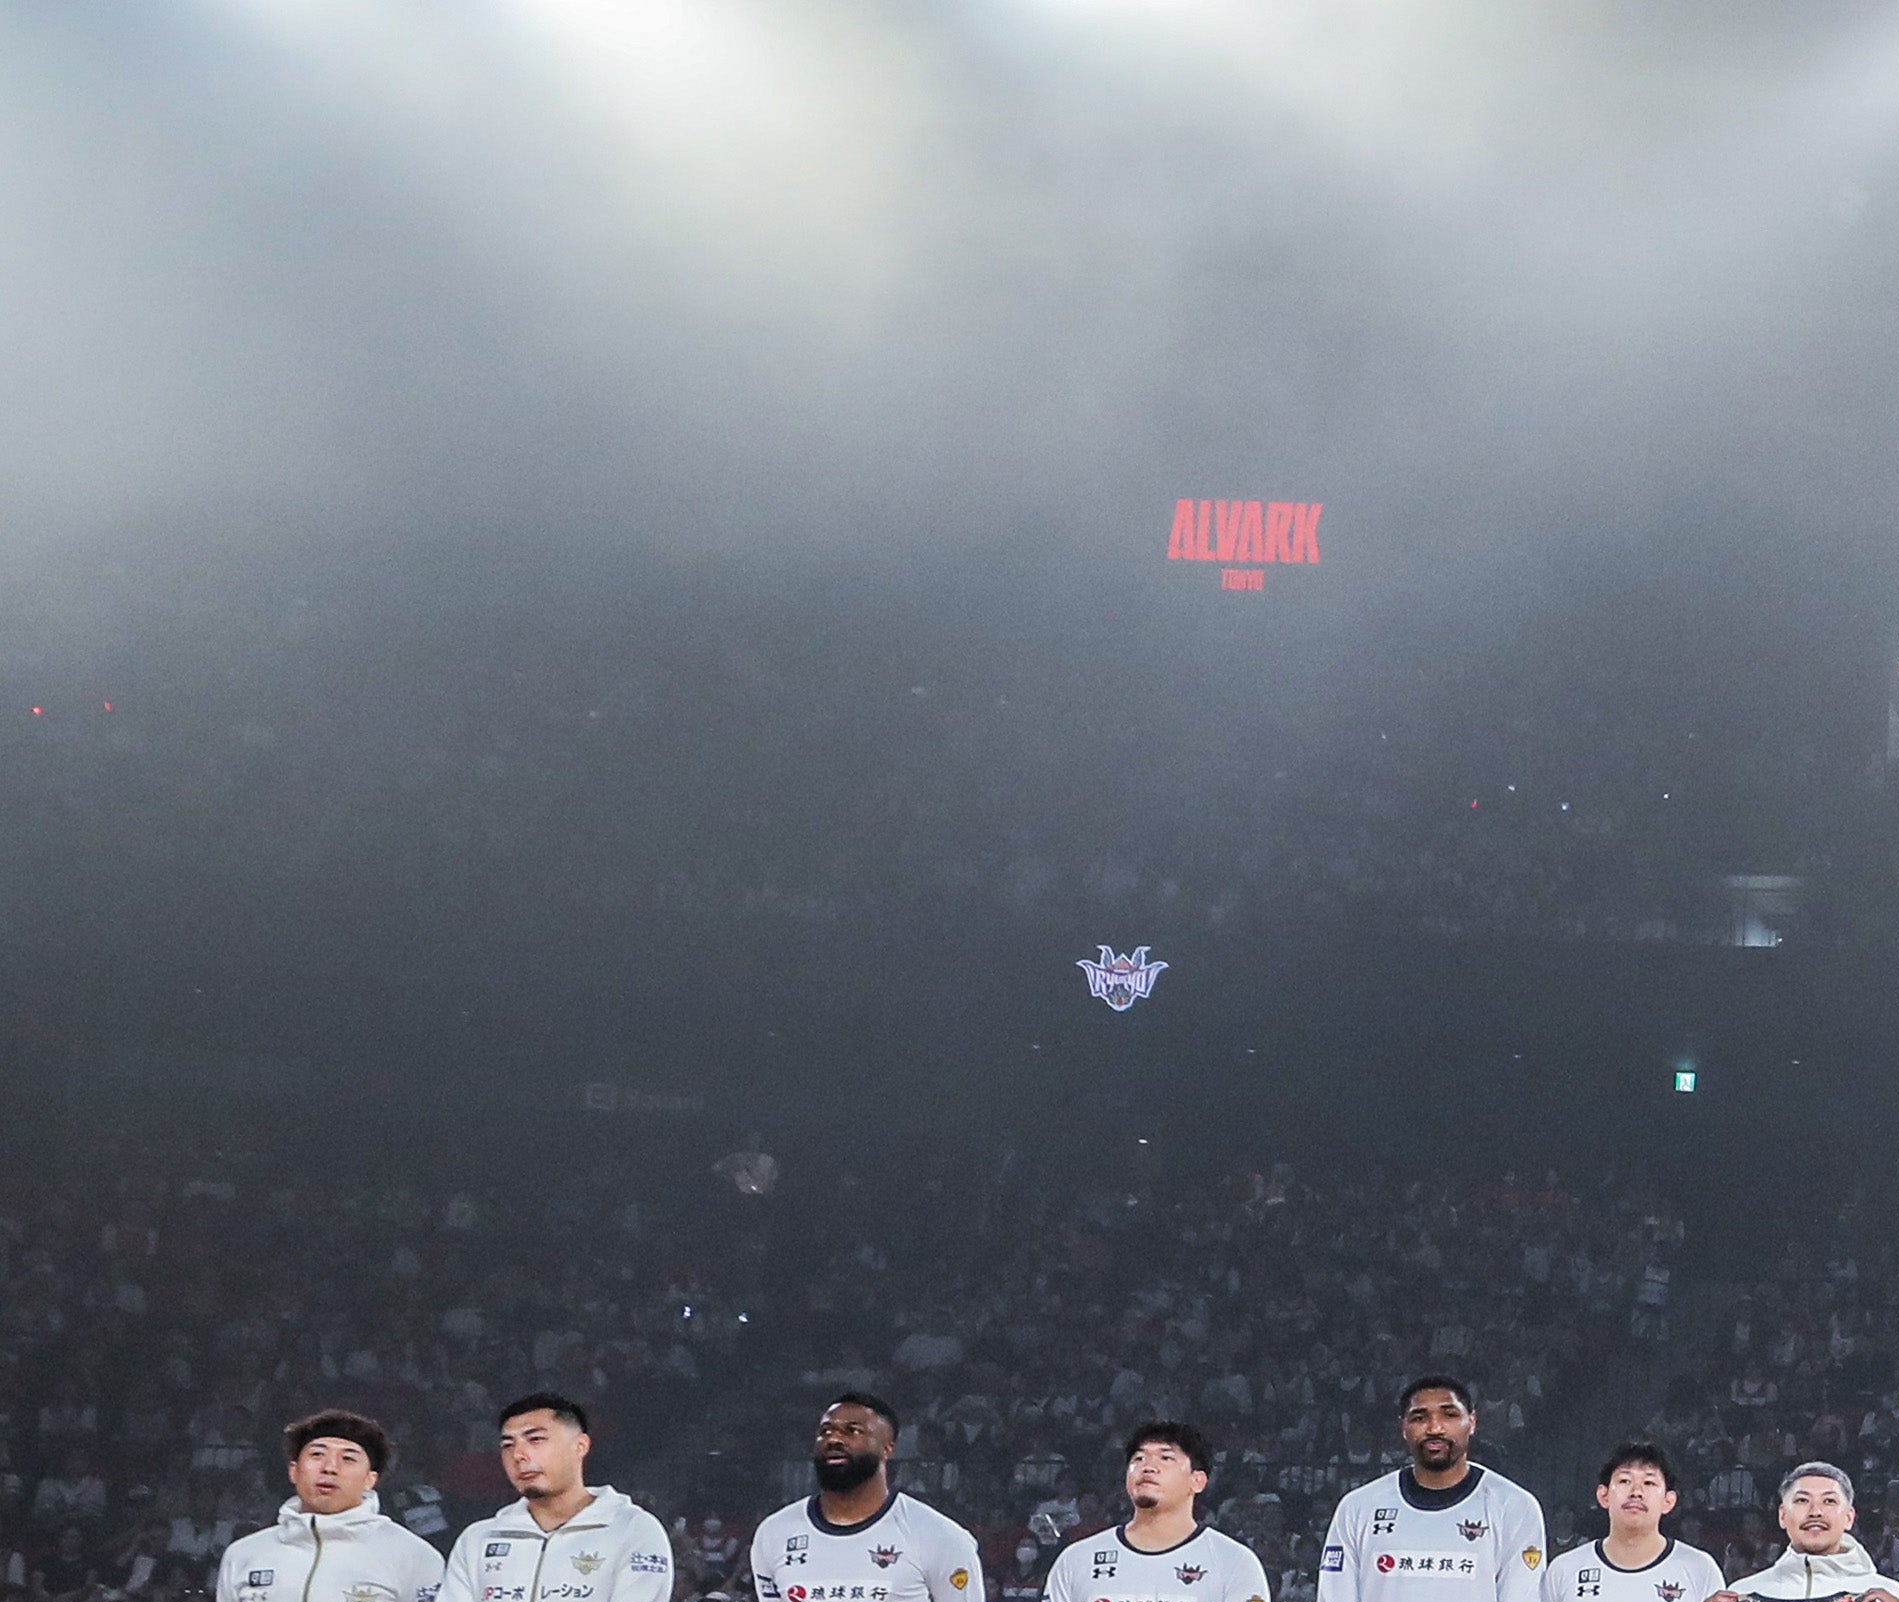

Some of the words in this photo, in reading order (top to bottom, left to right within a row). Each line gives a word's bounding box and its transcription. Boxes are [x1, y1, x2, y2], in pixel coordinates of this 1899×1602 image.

[1167, 498, 1324, 564] ALVARK
[1398, 1557, 1475, 1574] 琉球銀行
[810, 1585, 889, 1601] 琉球銀行
